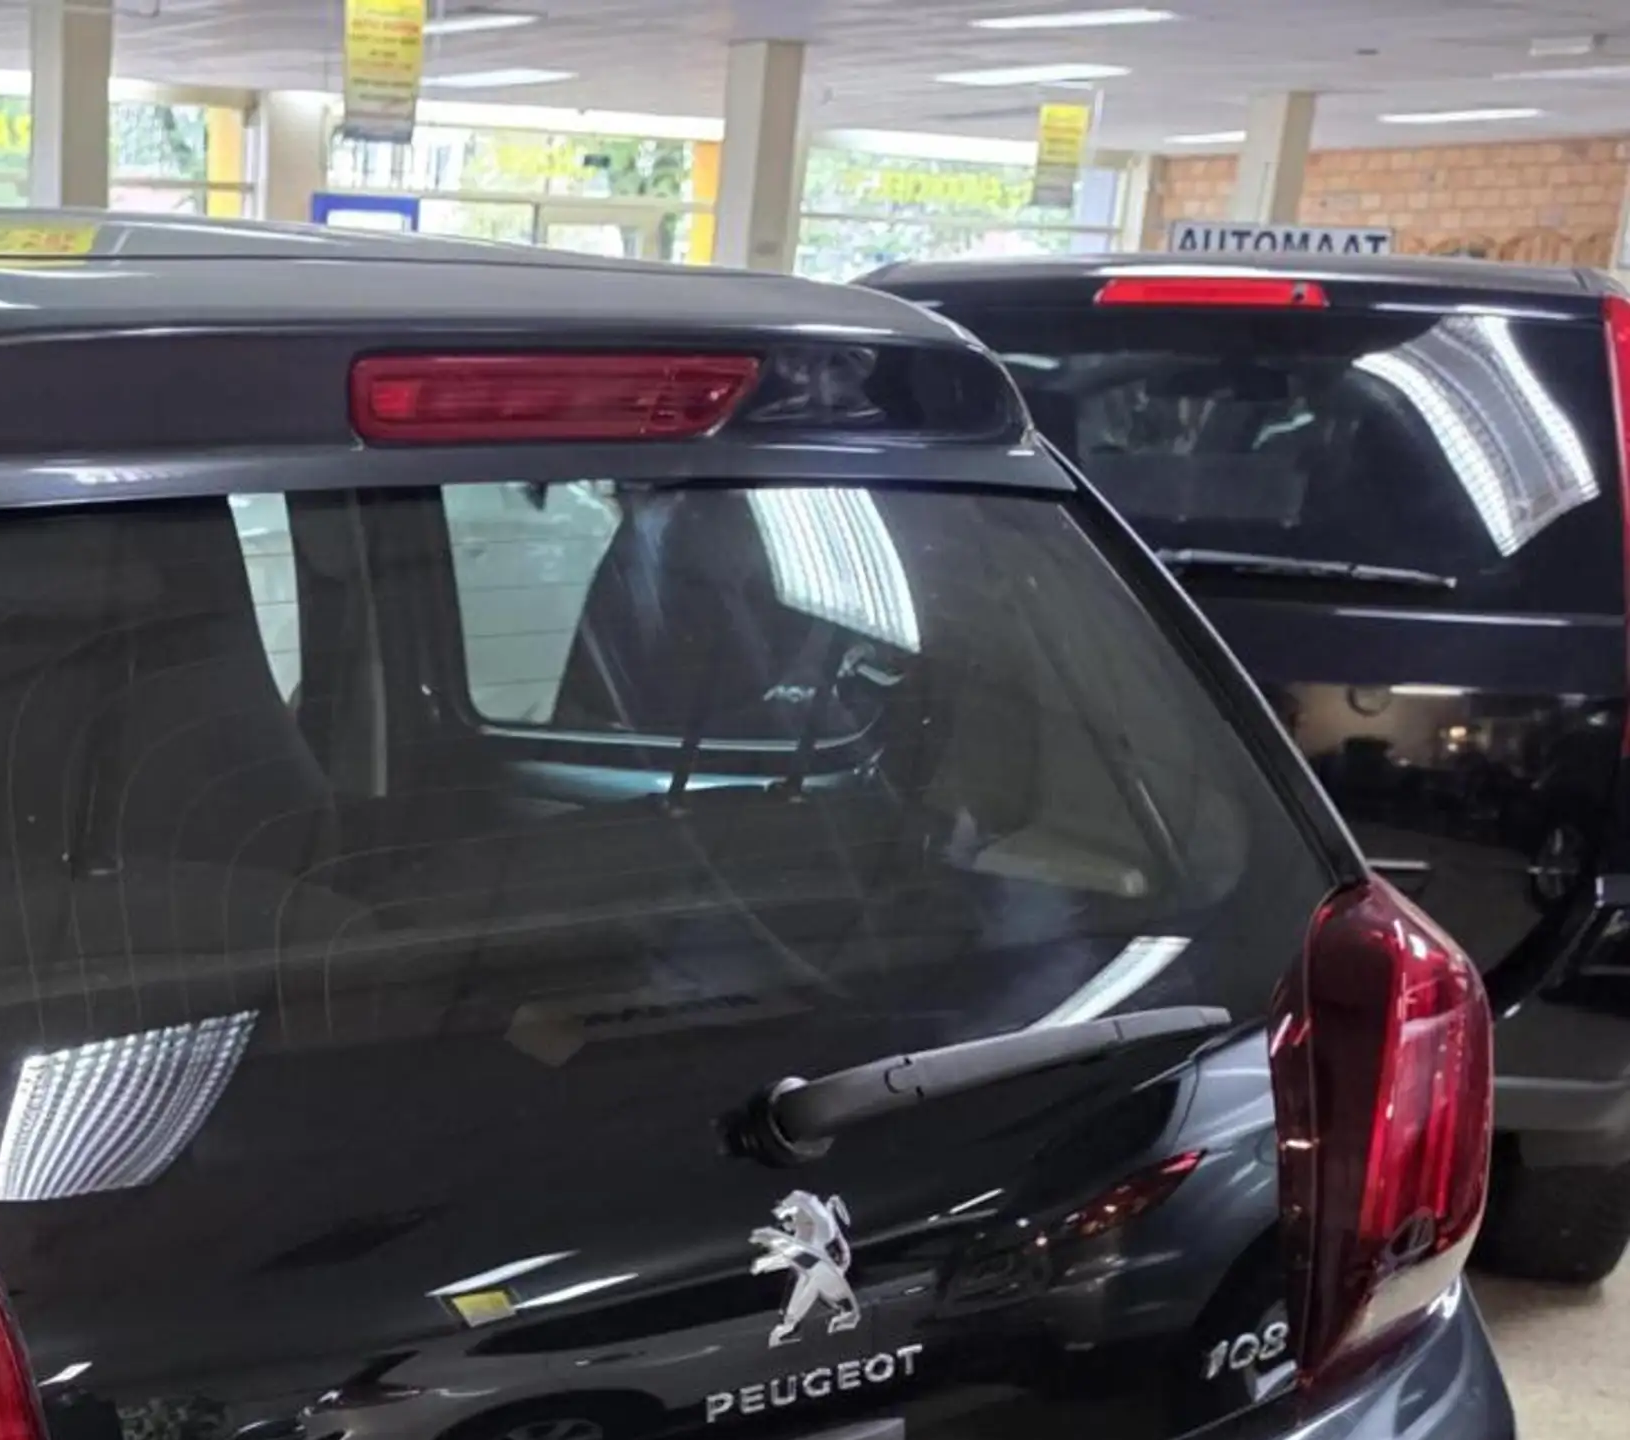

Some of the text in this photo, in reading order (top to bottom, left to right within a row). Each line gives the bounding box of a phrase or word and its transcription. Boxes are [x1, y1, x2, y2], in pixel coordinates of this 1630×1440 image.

[1178, 227, 1388, 254] AUTOMAAT
[1204, 1321, 1289, 1379] 108
[705, 1343, 924, 1423] PEUGEOT
